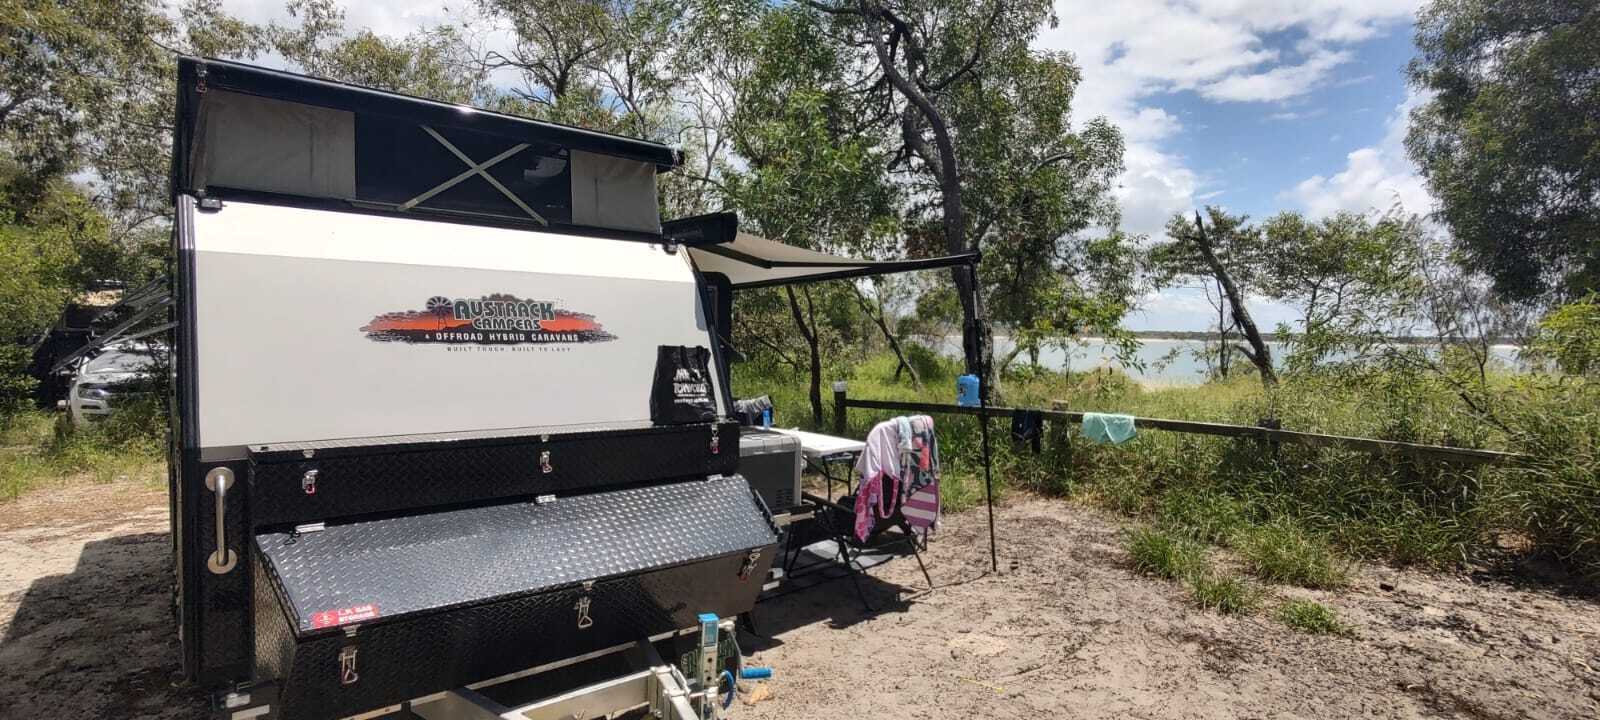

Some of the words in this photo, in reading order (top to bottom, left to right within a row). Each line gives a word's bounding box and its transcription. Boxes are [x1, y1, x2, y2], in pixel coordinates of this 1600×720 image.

[453, 299, 555, 320] AUSTRACK
[472, 319, 541, 331] CAMPERS
[435, 332, 483, 341] OFFROAD
[489, 333, 525, 342] HYBRID
[531, 333, 579, 342] CARAVANS
